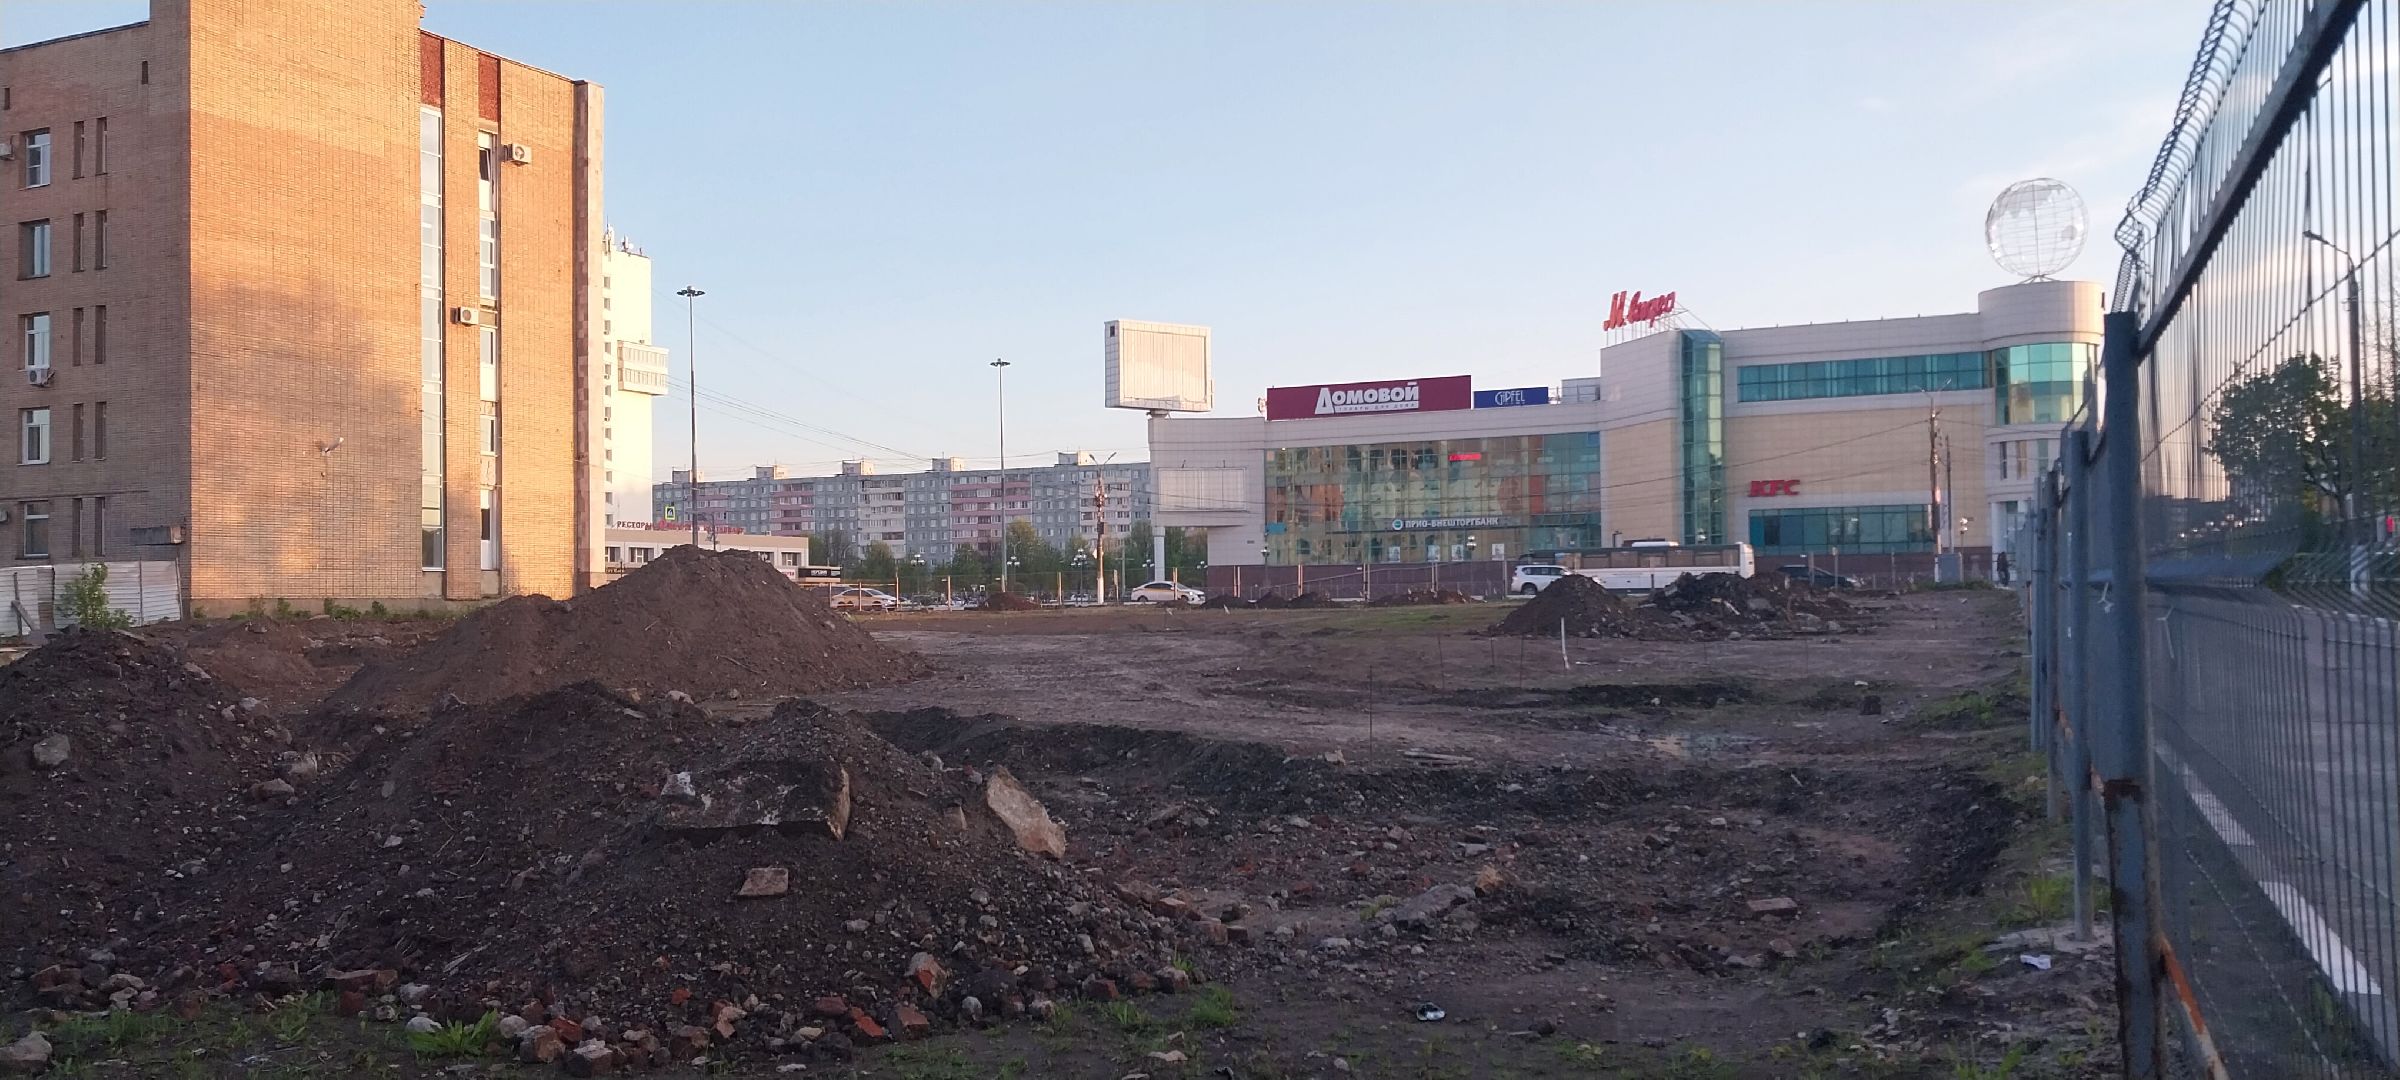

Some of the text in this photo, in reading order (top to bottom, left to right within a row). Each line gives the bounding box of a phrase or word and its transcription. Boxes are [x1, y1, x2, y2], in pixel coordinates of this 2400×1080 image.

[1314, 381, 1419, 415] ДОМОВОЙ
[1748, 479, 1801, 497] KFC
[1405, 517, 1499, 529] ПРИО-ВНЕШТОРГБАНК
